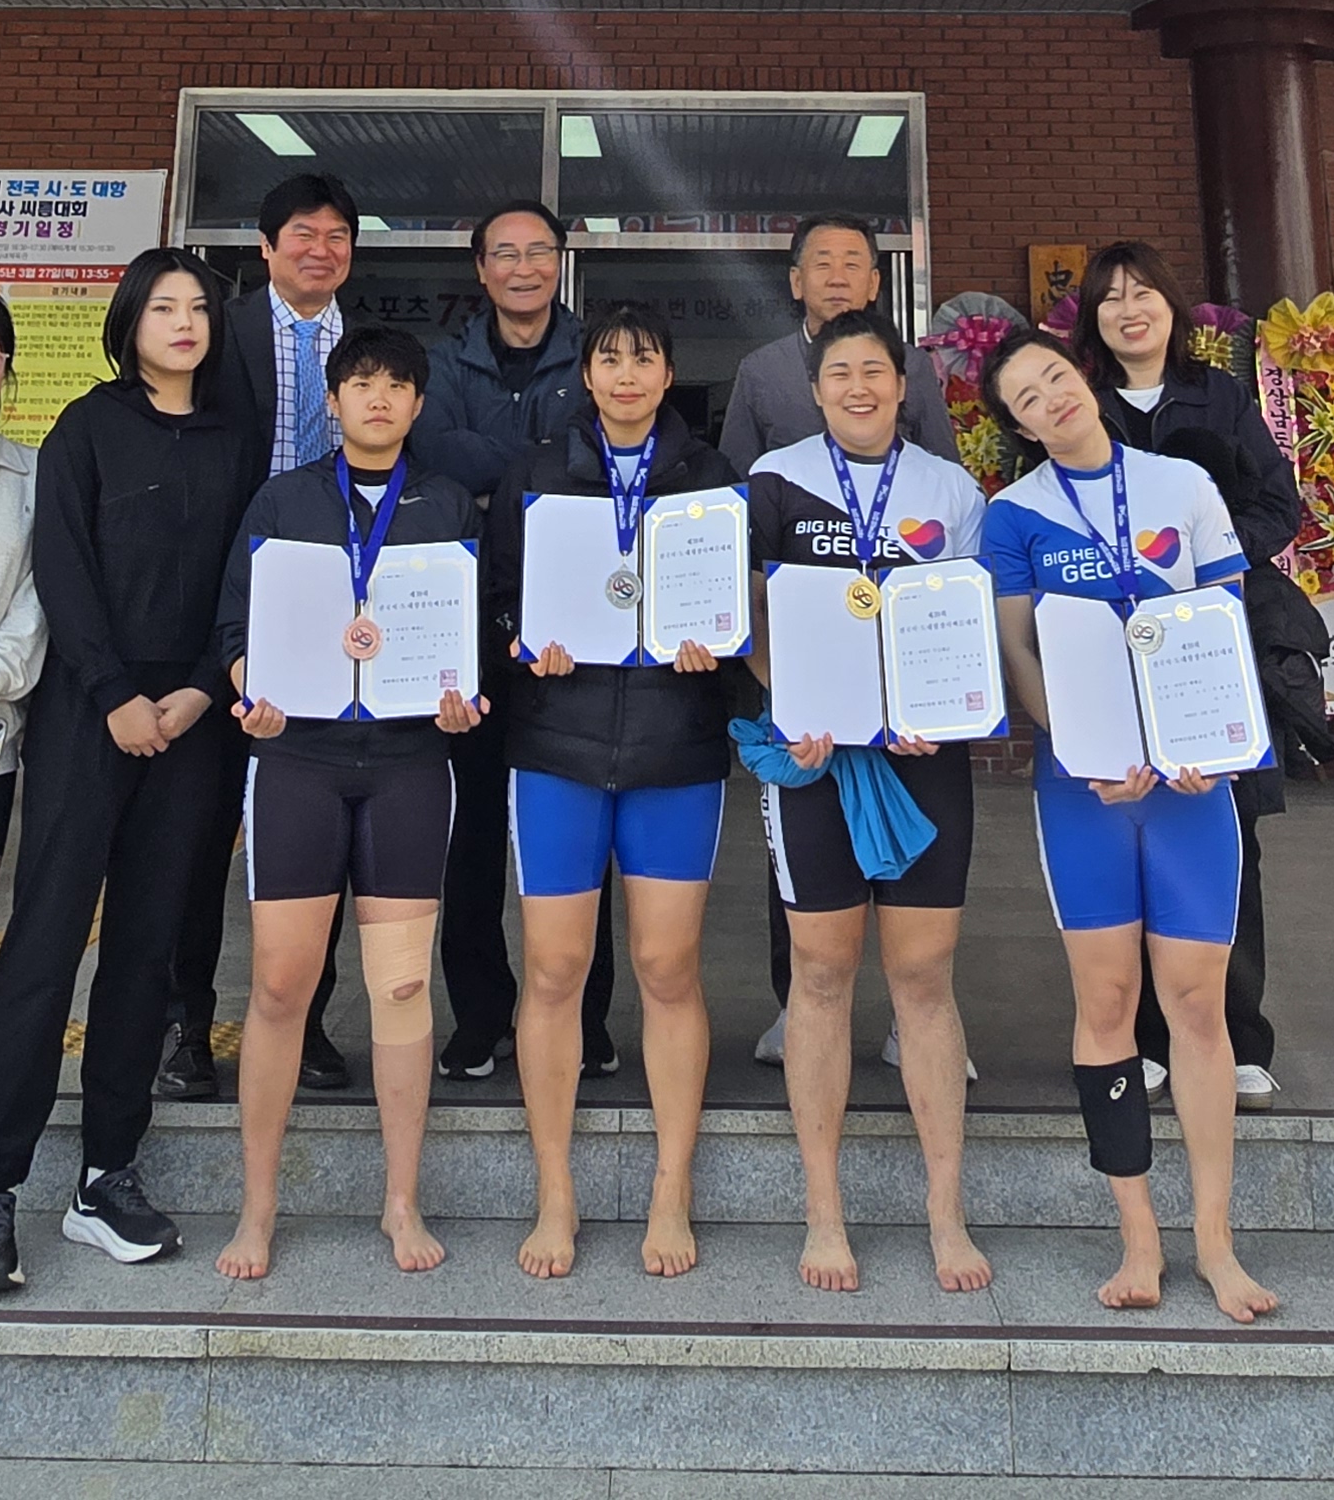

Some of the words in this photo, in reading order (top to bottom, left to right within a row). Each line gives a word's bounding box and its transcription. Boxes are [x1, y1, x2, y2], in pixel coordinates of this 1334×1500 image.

[6, 180, 40, 197] 전국
[92, 180, 127, 198] 대항
[795, 521, 824, 534] BIG
[1043, 549, 1070, 567] BIG
